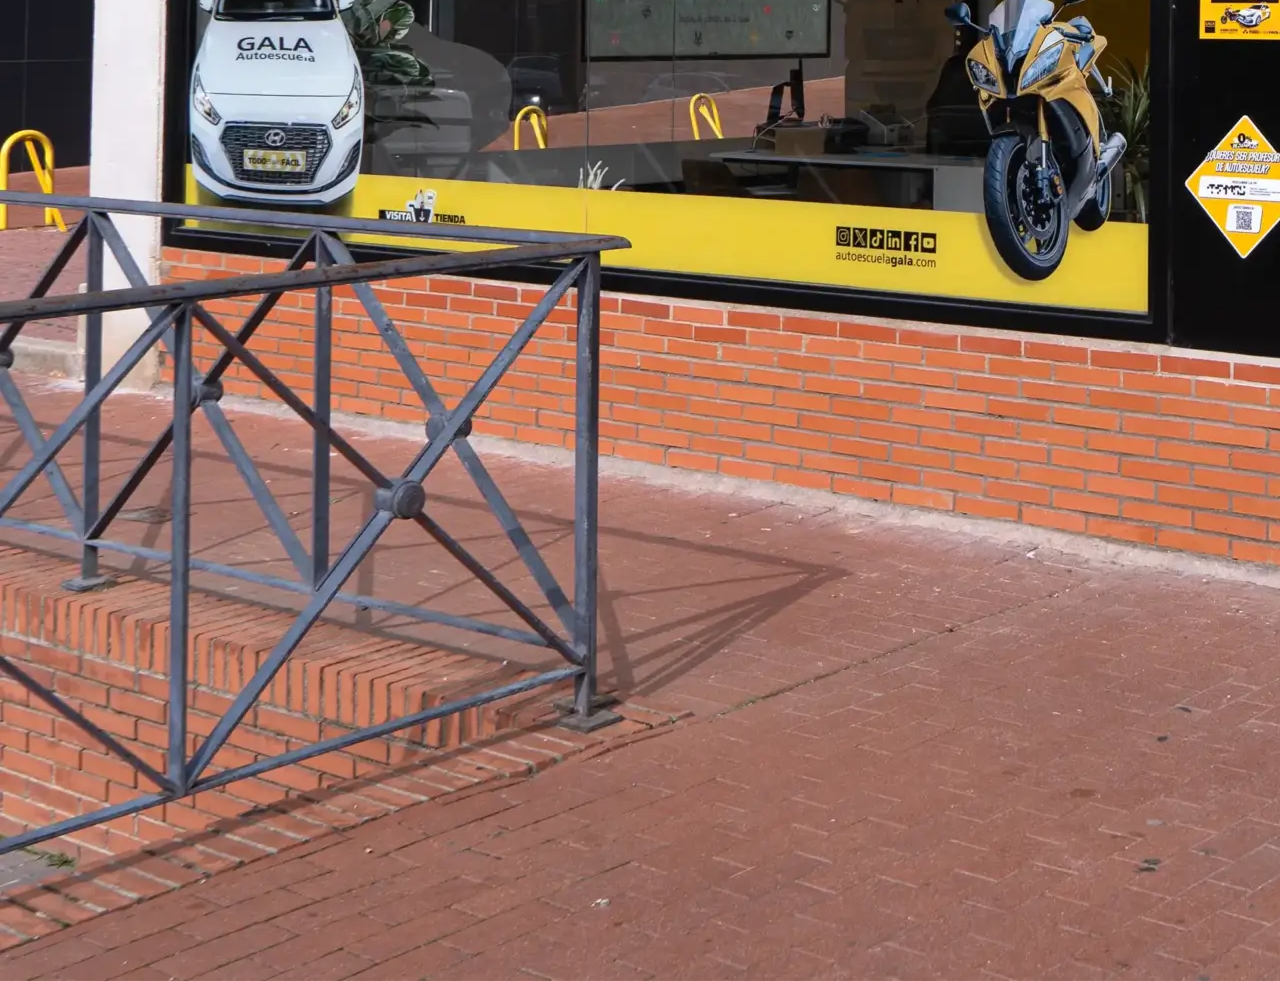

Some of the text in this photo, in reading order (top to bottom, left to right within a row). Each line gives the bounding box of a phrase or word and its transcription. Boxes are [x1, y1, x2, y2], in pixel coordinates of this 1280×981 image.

[237, 36, 314, 53] GALA
[1236, 151, 1248, 161] SER
[386, 211, 466, 224] VISITA TIENDA
[836, 251, 937, 268] autoescuelagala.com
